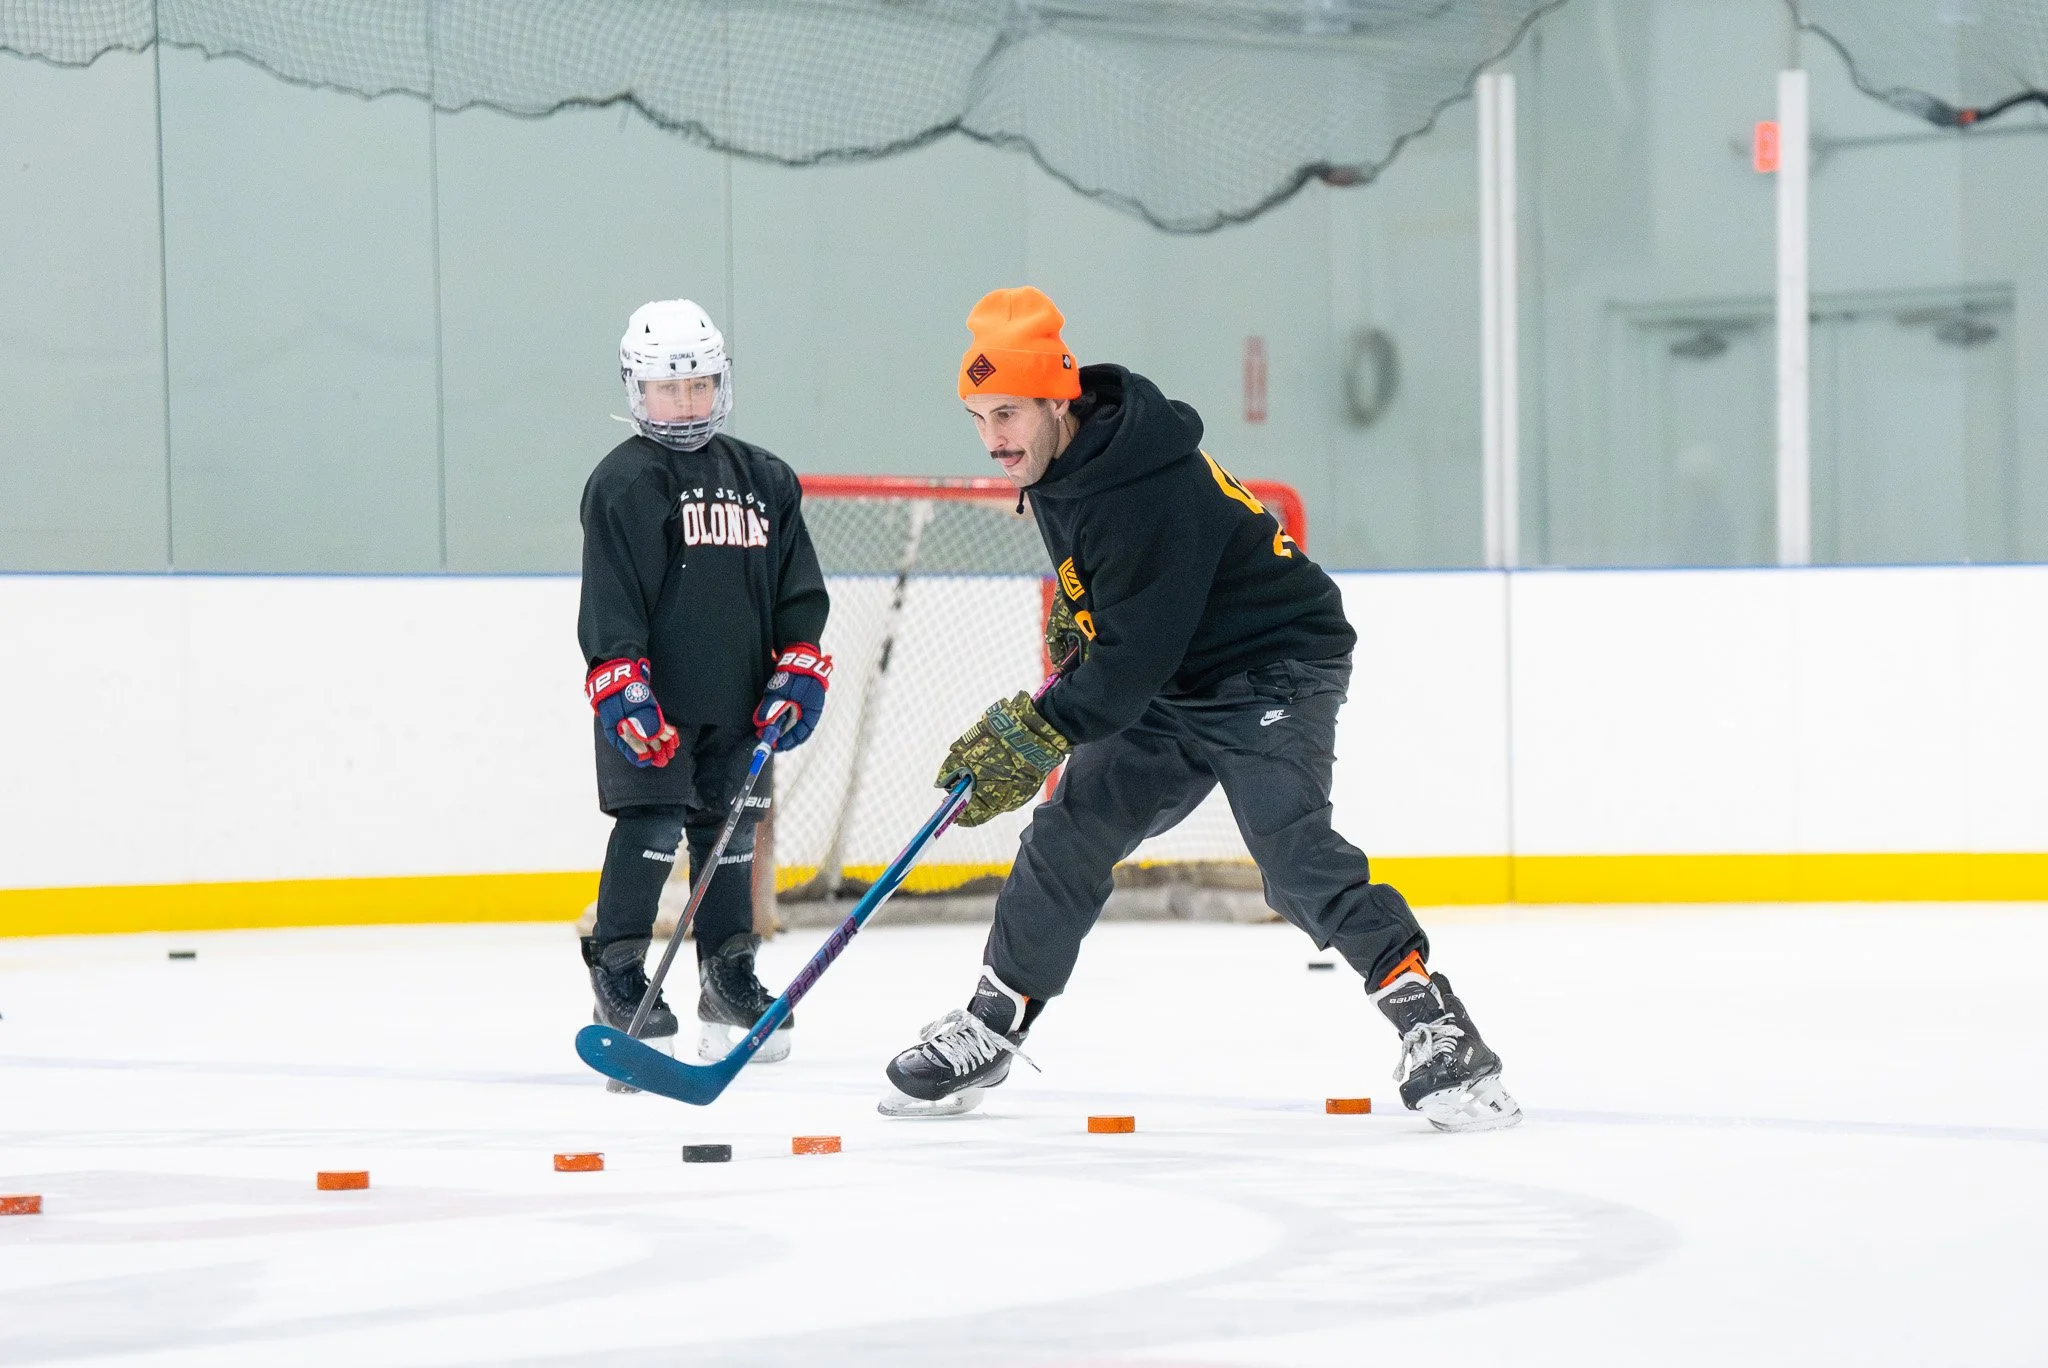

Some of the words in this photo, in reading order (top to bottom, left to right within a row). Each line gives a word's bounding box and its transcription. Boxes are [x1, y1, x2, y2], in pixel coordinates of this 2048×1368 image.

[1264, 709, 1285, 720] NIKE
[786, 916, 857, 1009] BAUER
[1389, 992, 1426, 1004] BAUER
